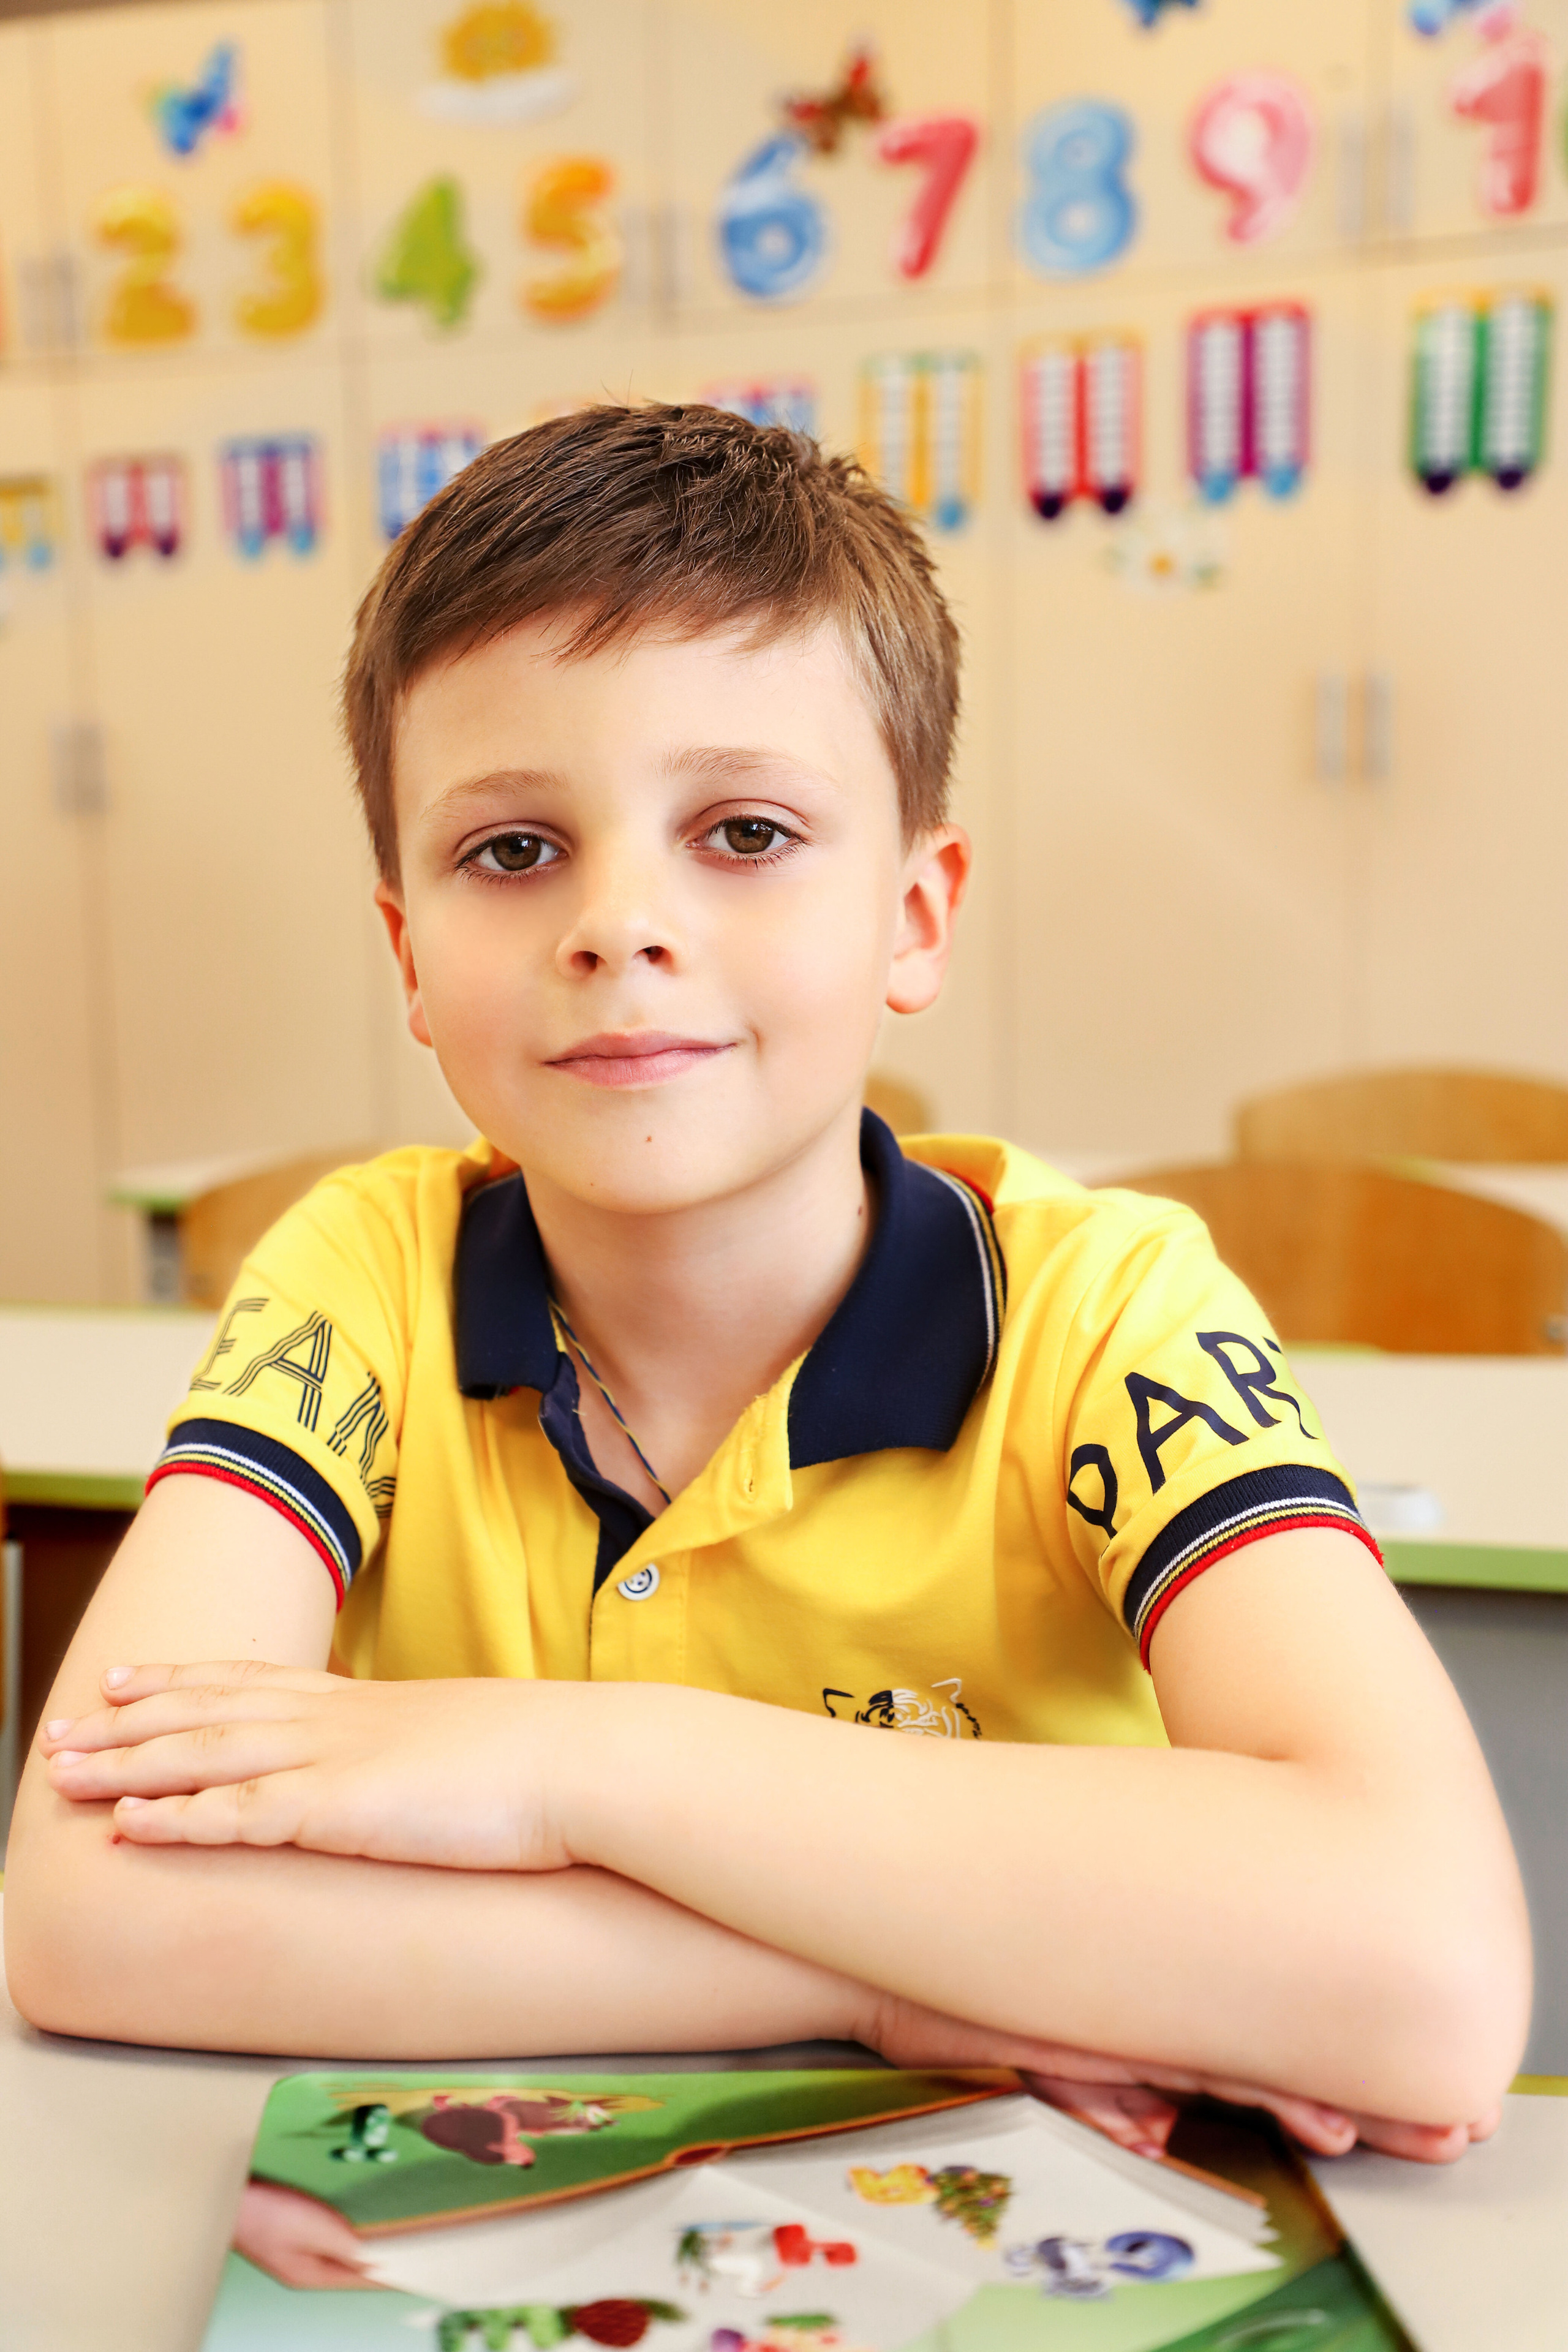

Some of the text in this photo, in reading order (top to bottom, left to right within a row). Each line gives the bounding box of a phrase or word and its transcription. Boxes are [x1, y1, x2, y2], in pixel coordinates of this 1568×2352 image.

[95, 34, 1568, 347] 2 3 4 5 6 7 8 9 1
[1067, 1331, 1319, 1541] PAR
